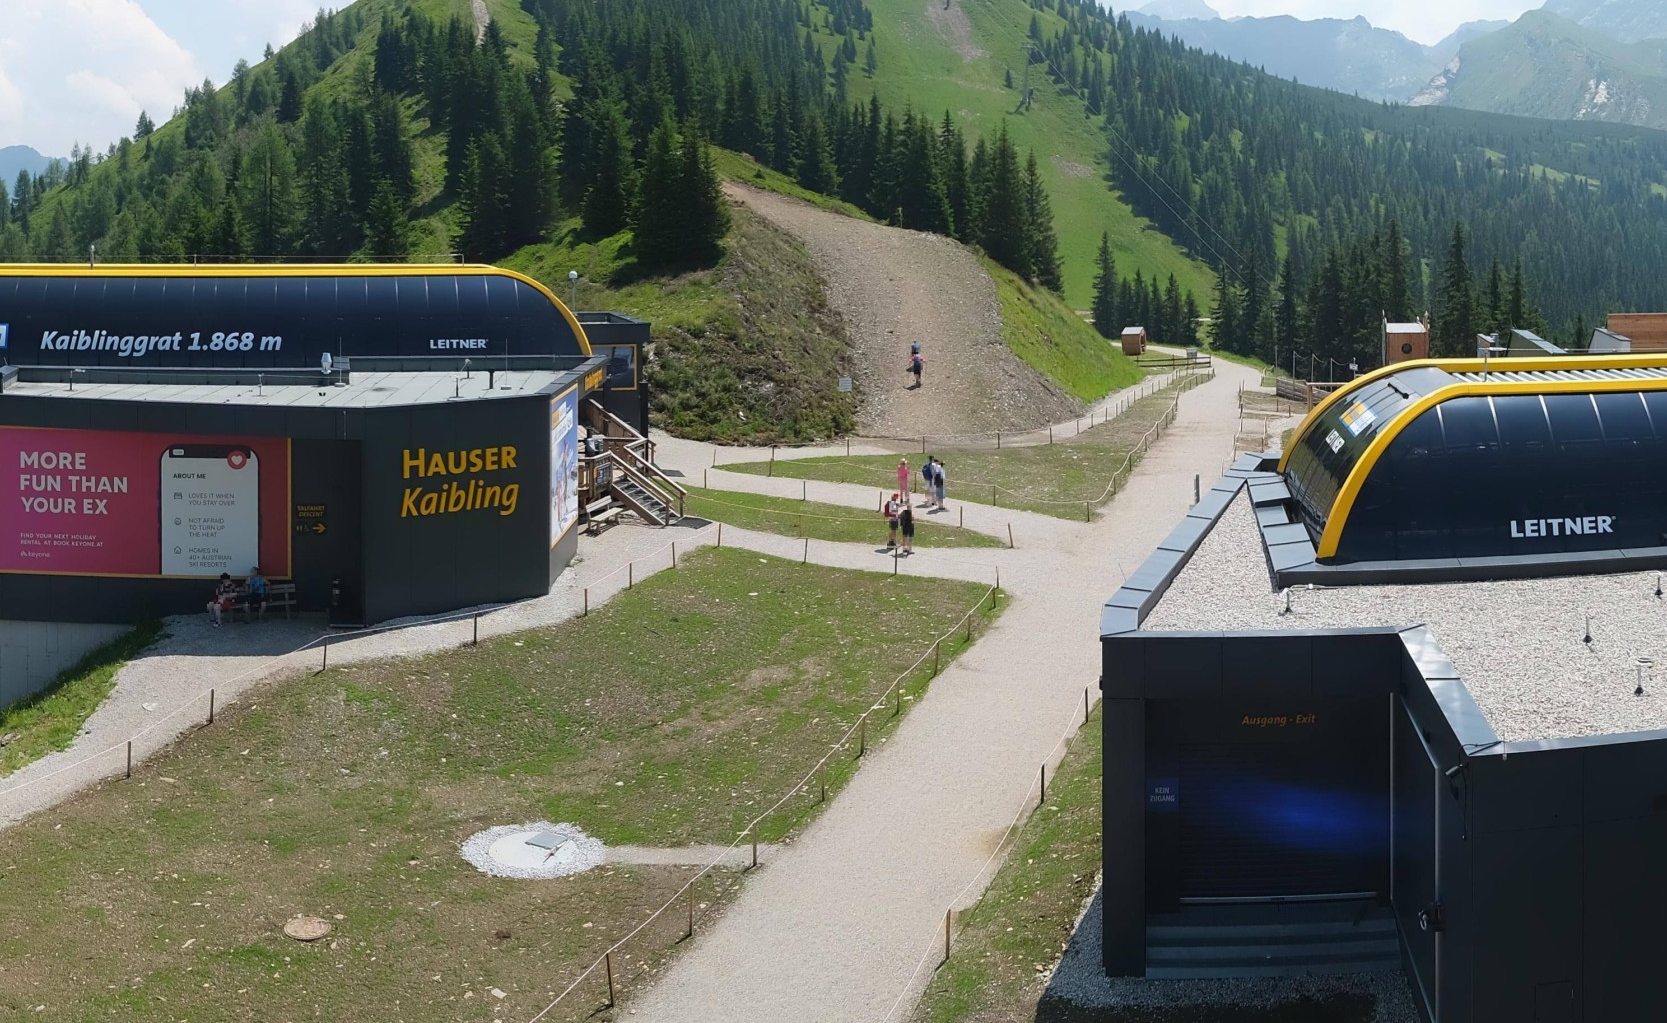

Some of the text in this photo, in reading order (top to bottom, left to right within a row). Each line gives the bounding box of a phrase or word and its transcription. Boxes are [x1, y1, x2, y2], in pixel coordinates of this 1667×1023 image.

[40, 329, 282, 357] Kaiblinggrat 1.868 m
[429, 338, 487, 349] LEITNER
[20, 451, 86, 470] MORE
[402, 445, 518, 479] HAUSER
[20, 474, 128, 493] FUN THAN
[21, 496, 109, 515] YOUR EX
[400, 479, 520, 518] Kaibling
[1510, 515, 1615, 538] LEITNER
[1241, 715, 1287, 727] Ausgang
[1295, 714, 1316, 724] Exit
[1154, 786, 1170, 794] KEIN
